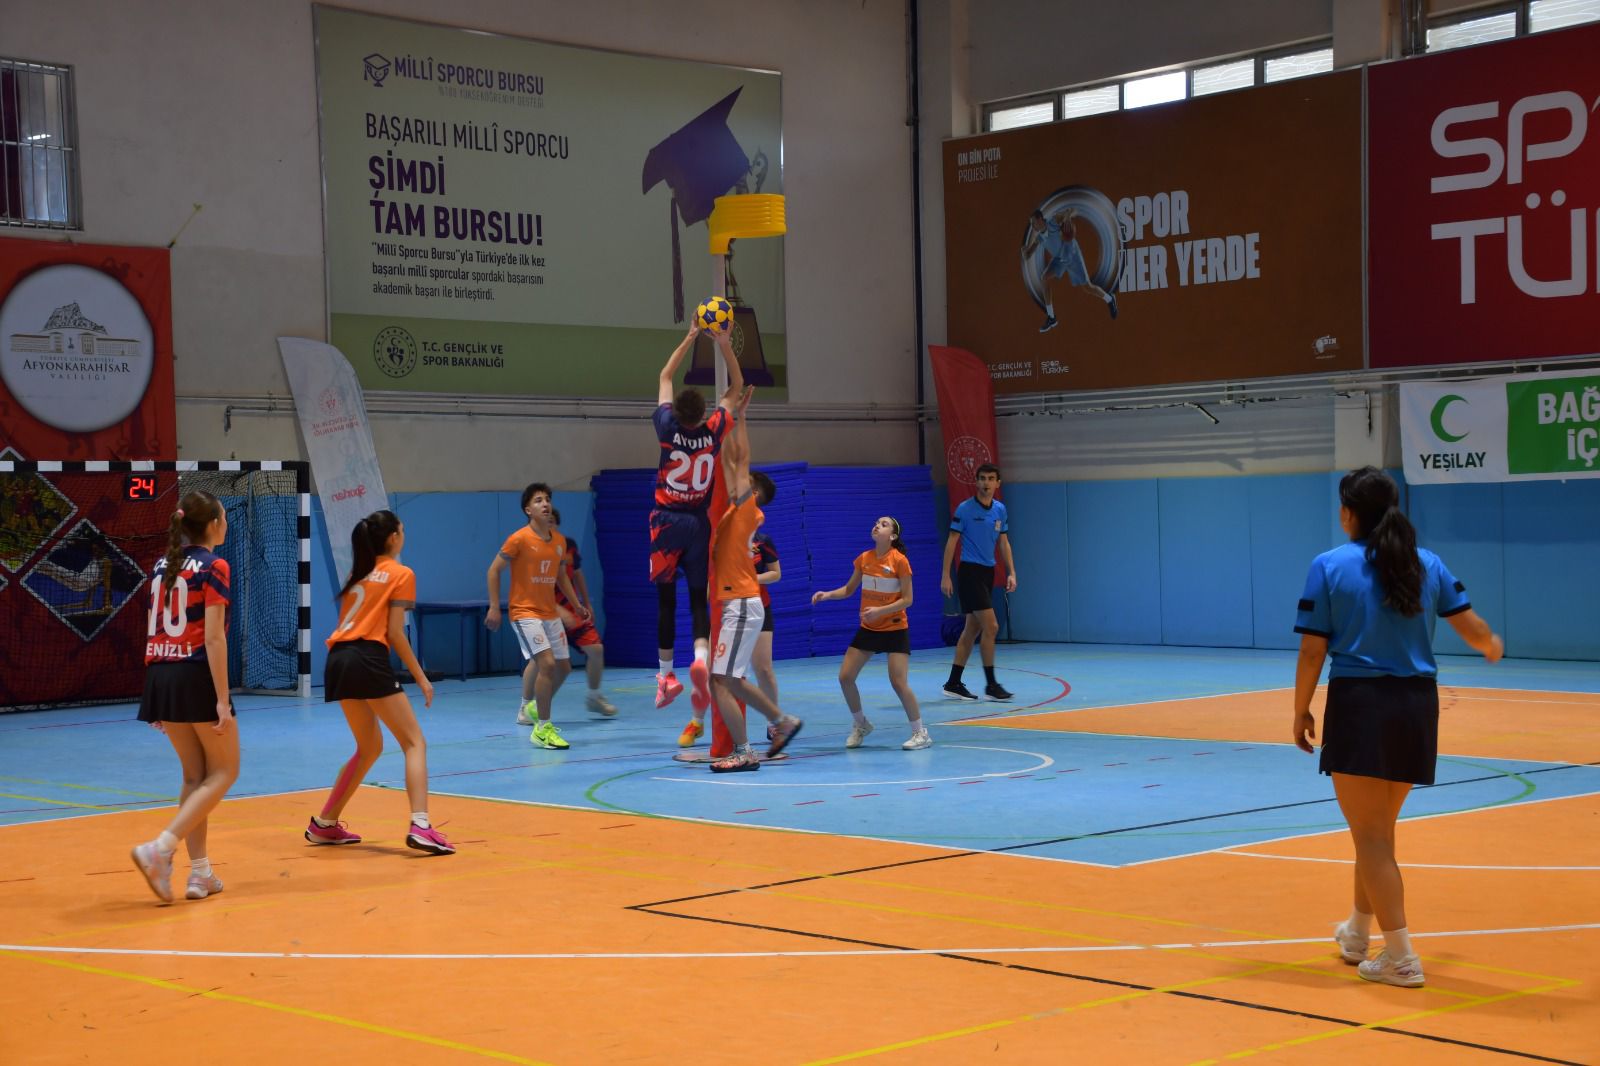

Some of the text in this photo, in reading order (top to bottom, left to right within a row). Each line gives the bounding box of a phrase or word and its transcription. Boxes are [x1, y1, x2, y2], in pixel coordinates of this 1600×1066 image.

[438, 63, 494, 88] SPORCU
[498, 71, 544, 95] BURSU
[366, 113, 569, 159] BAŞARILI MİLLÎ SPORCU
[1430, 90, 1600, 194] SP
[958, 147, 1001, 166] ON BİN POTA
[369, 150, 445, 198] ŞİMDİ
[370, 200, 543, 246] TAM BURSLU!
[1116, 190, 1190, 243] SPOR
[398, 246, 428, 262] Sporcu
[476, 251, 518, 267] Türkiye'de
[519, 254, 530, 265] ilk
[532, 255, 545, 267] kez
[1430, 189, 1600, 304] TÜ
[372, 262, 405, 278] başarılı
[430, 268, 469, 281] sporcular
[472, 271, 505, 284] spordaki
[507, 272, 544, 286] başarısını
[1118, 232, 1261, 293] HER YERDE
[373, 282, 412, 295] akademik
[415, 284, 440, 297] başarı
[442, 285, 452, 298] ile
[422, 342, 503, 355] T.C. GENÇLİK VE
[422, 356, 504, 368] SPOR BAKANLIĞI
[673, 432, 712, 450] AYDIN
[1567, 428, 1600, 467] İÇ
[666, 450, 714, 491] 20
[1419, 452, 1486, 472] YEŞİLAY
[130, 478, 154, 498] 24
[153, 556, 203, 573] ÇEİN
[540, 560, 551, 574] 17
[148, 574, 188, 638] 10
[339, 584, 365, 632] 2
[146, 640, 192, 658] ENİZLİ
